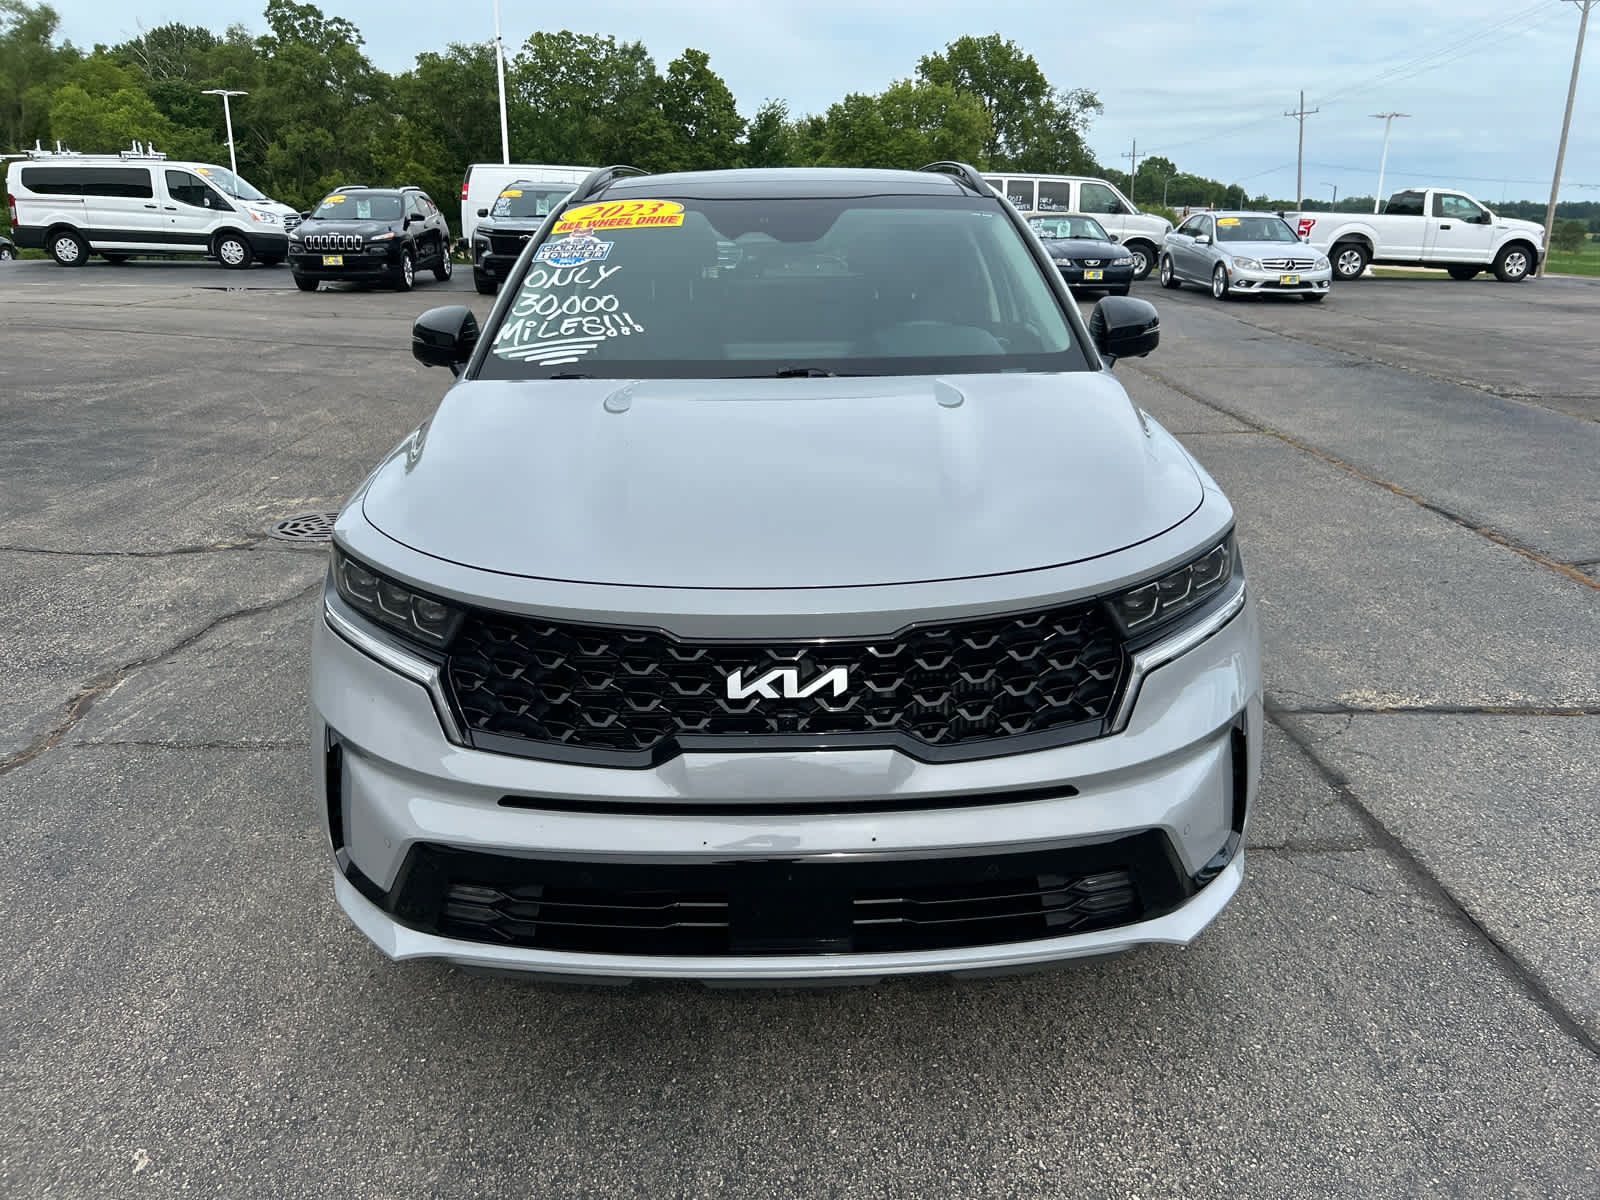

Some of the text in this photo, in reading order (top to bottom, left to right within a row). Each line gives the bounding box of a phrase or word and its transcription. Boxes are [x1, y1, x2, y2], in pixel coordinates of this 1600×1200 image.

[558, 216, 681, 231] ALL WHEEL DRIVE
[580, 203, 664, 220] 2023
[524, 265, 622, 289] ONLY
[512, 293, 619, 320] 30,000
[726, 668, 848, 699] KIA
